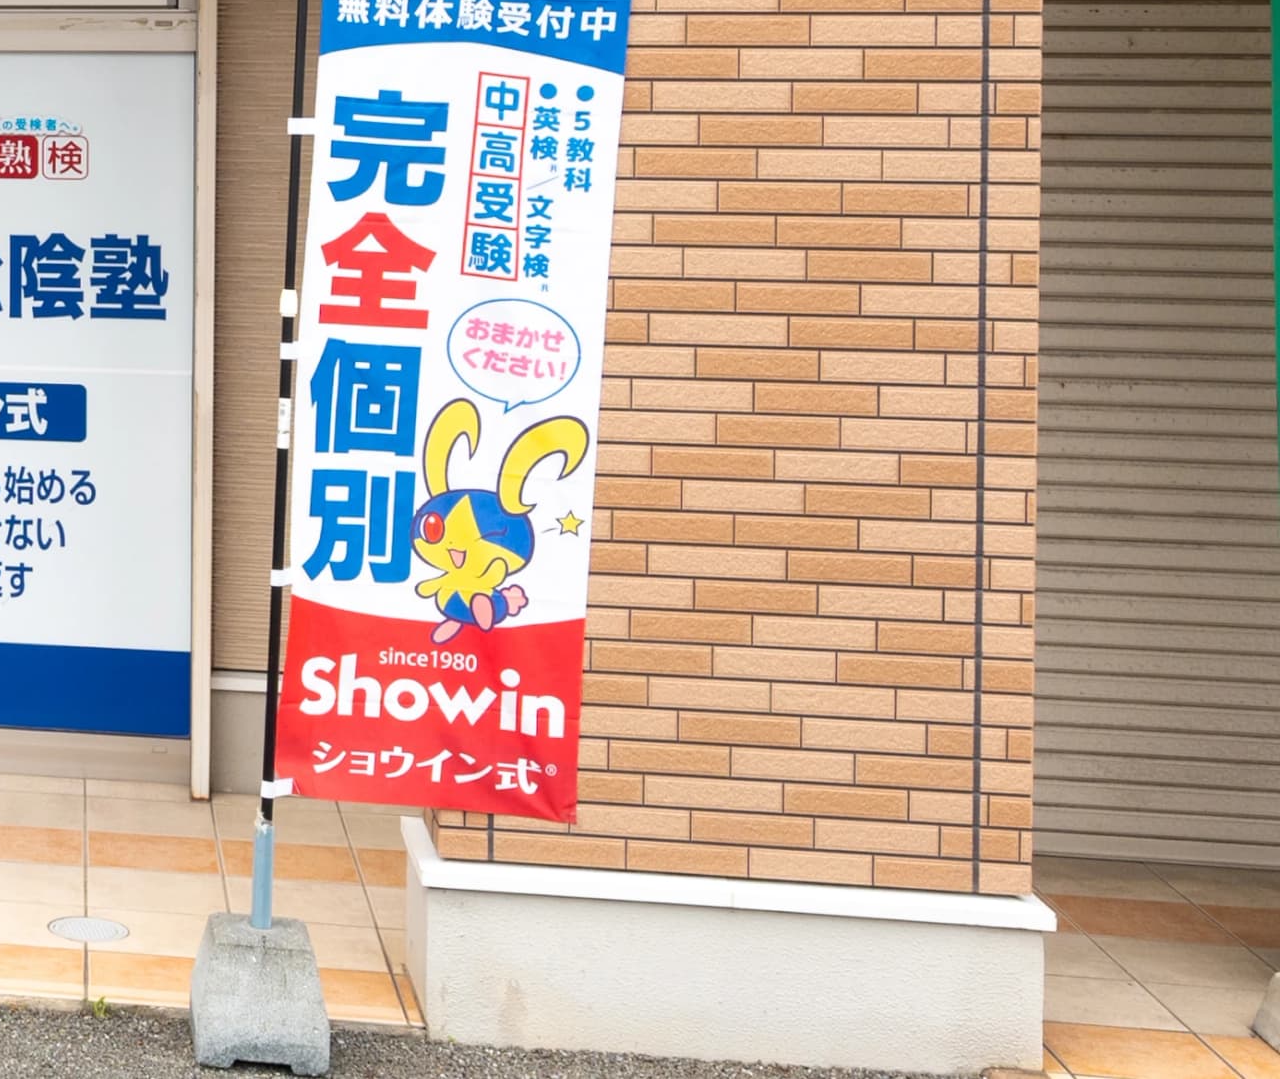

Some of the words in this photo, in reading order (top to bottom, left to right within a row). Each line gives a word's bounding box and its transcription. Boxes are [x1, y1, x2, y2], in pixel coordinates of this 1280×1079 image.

[468, 80, 520, 275] 中高受験
[303, 89, 449, 584] 完全個別
[465, 317, 565, 353] おまかせ
[299, 653, 565, 739] Showin
[379, 647, 477, 673] since1980
